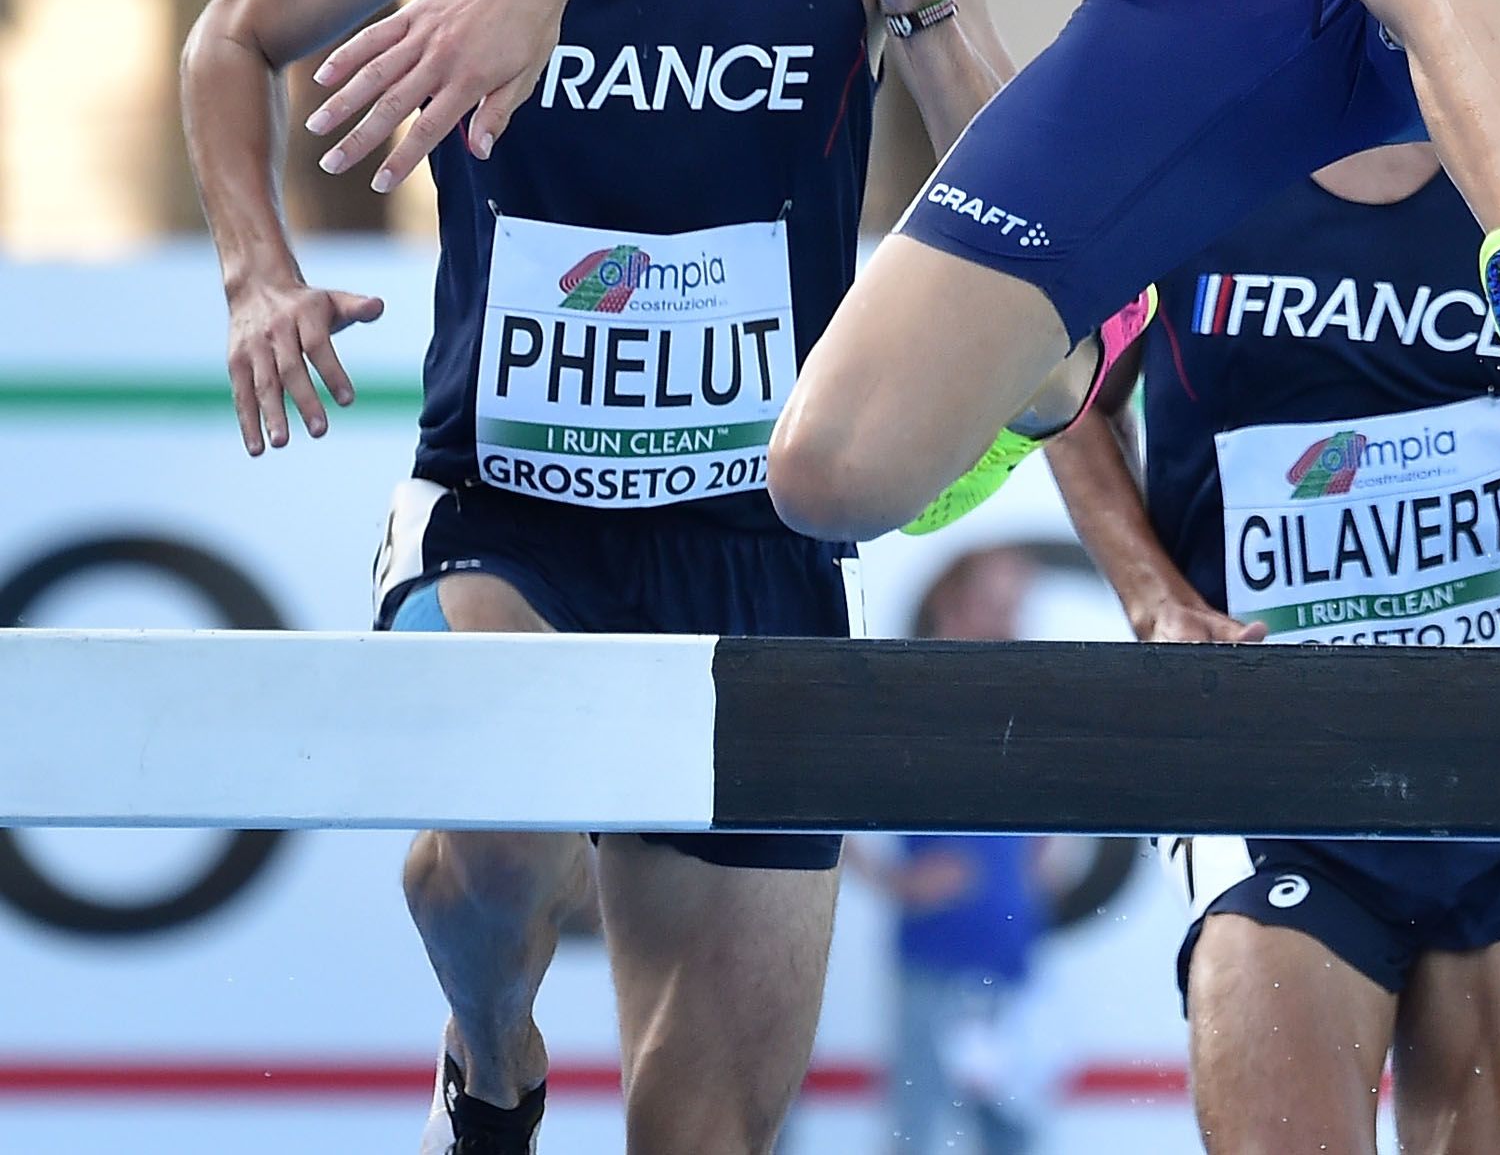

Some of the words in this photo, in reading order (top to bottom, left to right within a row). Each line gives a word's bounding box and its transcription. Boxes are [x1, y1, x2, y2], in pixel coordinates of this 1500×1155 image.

[541, 44, 814, 111] RANCE
[928, 183, 1028, 235] CRAFT
[600, 251, 726, 297] olimpia
[629, 295, 717, 312] costruzioni
[496, 315, 780, 408] PHELUT
[547, 427, 554, 450] I
[562, 430, 622, 454] RUN
[1322, 427, 1456, 472] olimpia
[483, 454, 697, 501] GROSSETO
[1297, 605, 1307, 628] I
[1312, 598, 1368, 625] RUN
